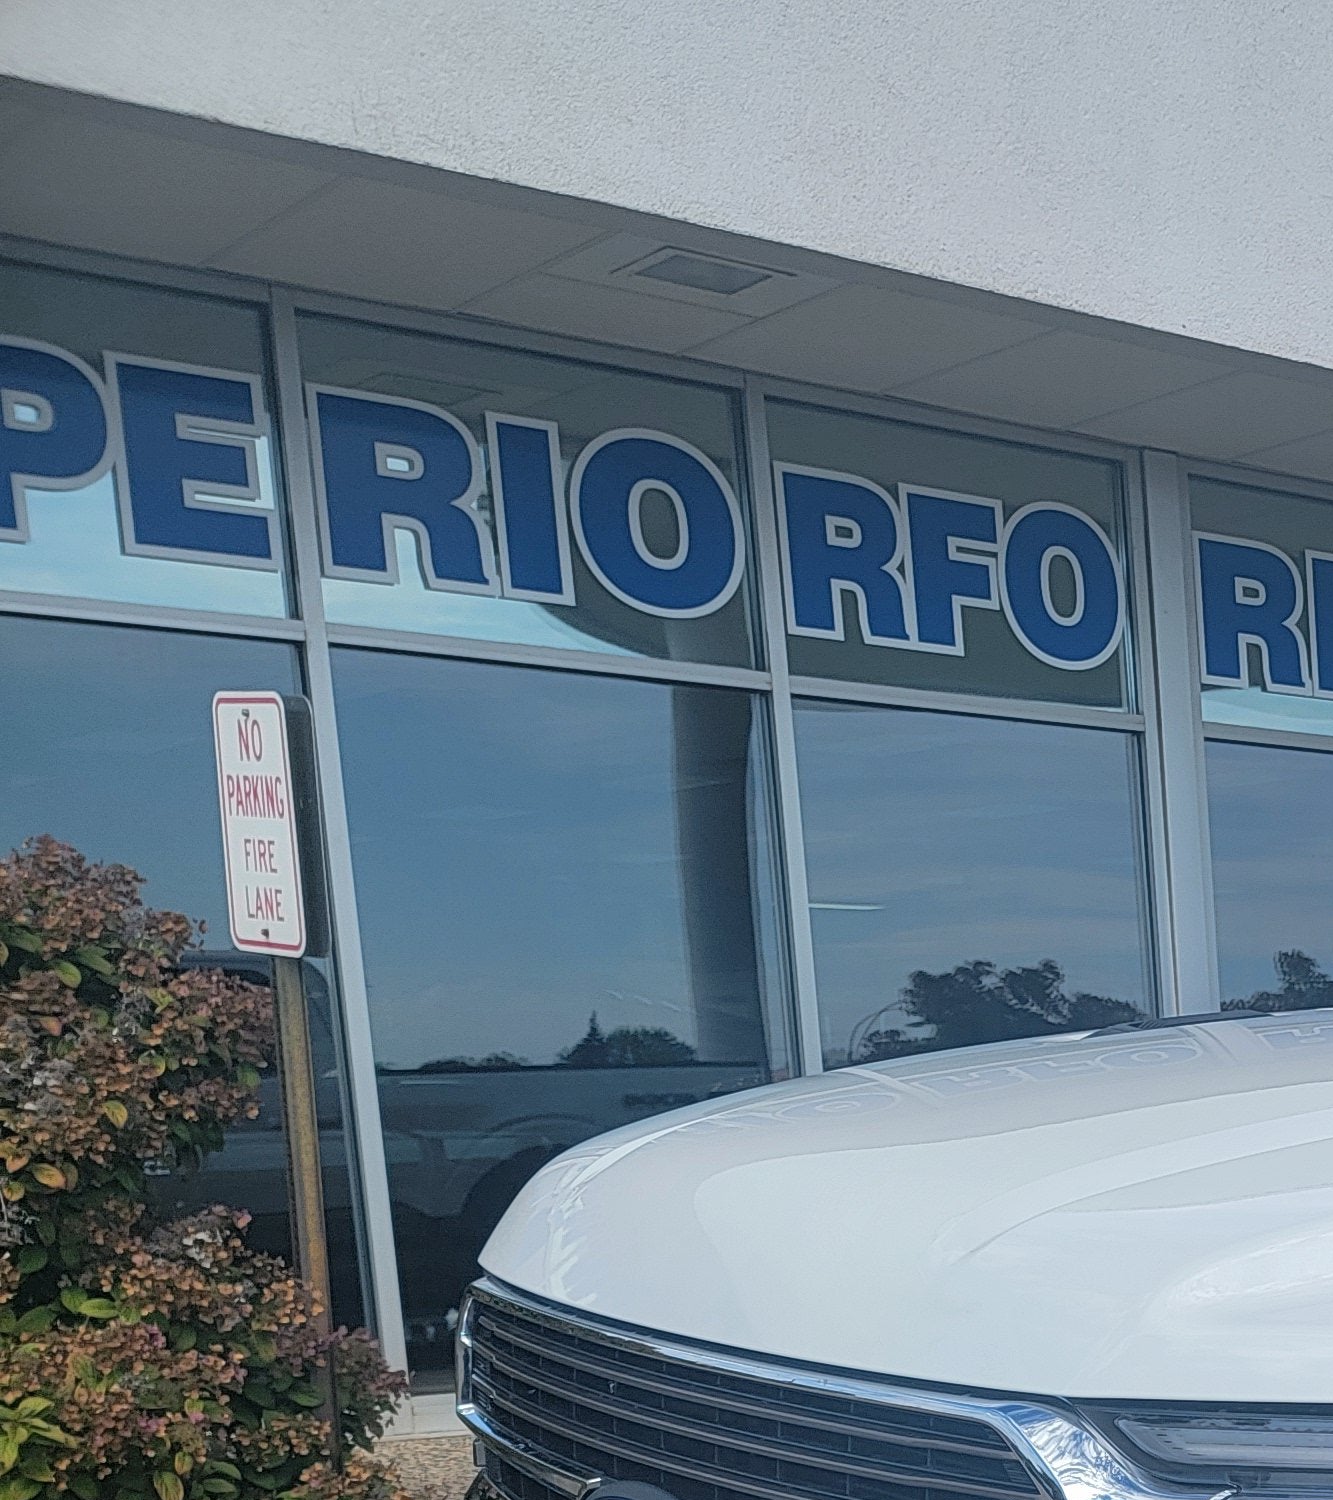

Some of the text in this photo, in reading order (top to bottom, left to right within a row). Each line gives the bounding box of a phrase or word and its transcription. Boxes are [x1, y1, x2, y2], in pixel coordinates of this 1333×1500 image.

[237, 719, 263, 762] NO
[226, 773, 285, 819] PARKING
[243, 838, 278, 874] FIRE
[245, 885, 285, 922] LANE
